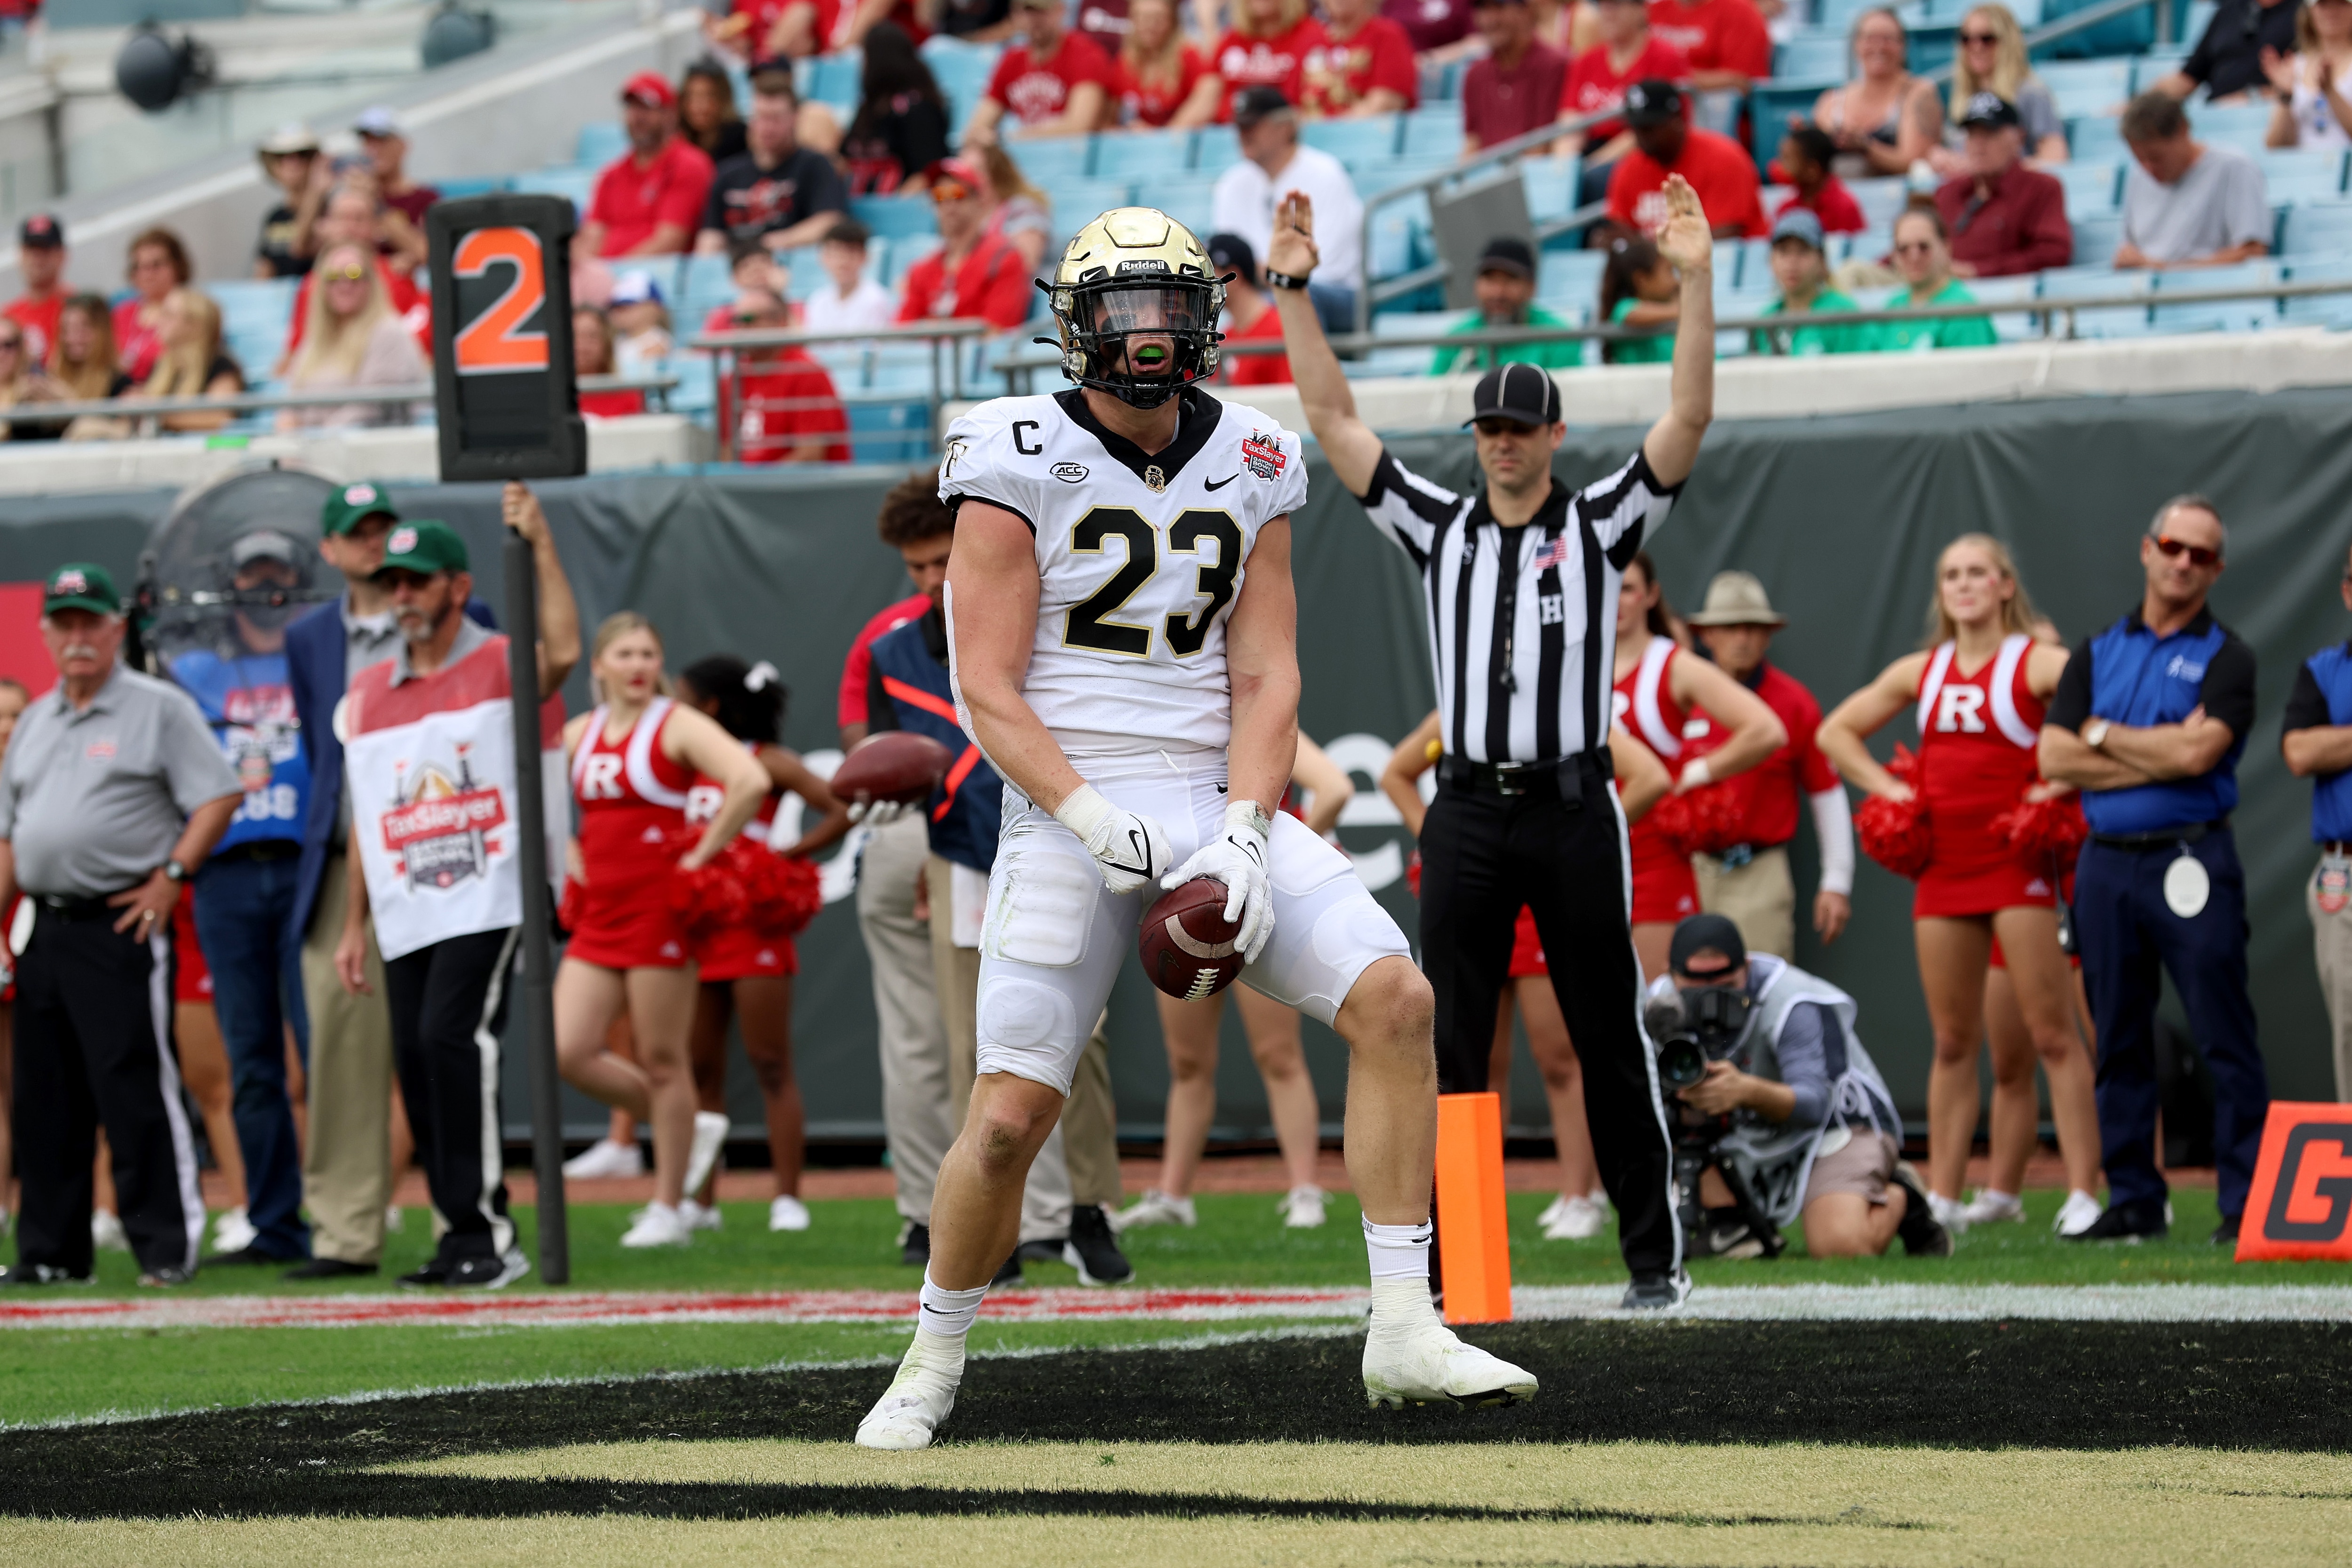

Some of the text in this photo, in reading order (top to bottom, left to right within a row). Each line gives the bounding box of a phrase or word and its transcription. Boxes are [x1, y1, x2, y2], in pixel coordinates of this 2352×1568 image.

[1121, 261, 1165, 271] Riddell
[452, 226, 550, 376] 2
[1012, 420, 1042, 455] C
[1245, 442, 1284, 463] TaxSlayer
[1253, 461, 1272, 472] BOWL
[1062, 504, 1245, 659] 23
[1540, 593, 1564, 626] H
[1934, 684, 1986, 733] R
[581, 753, 625, 800] R
[684, 785, 724, 824] R
[2263, 1123, 2352, 1241] G
